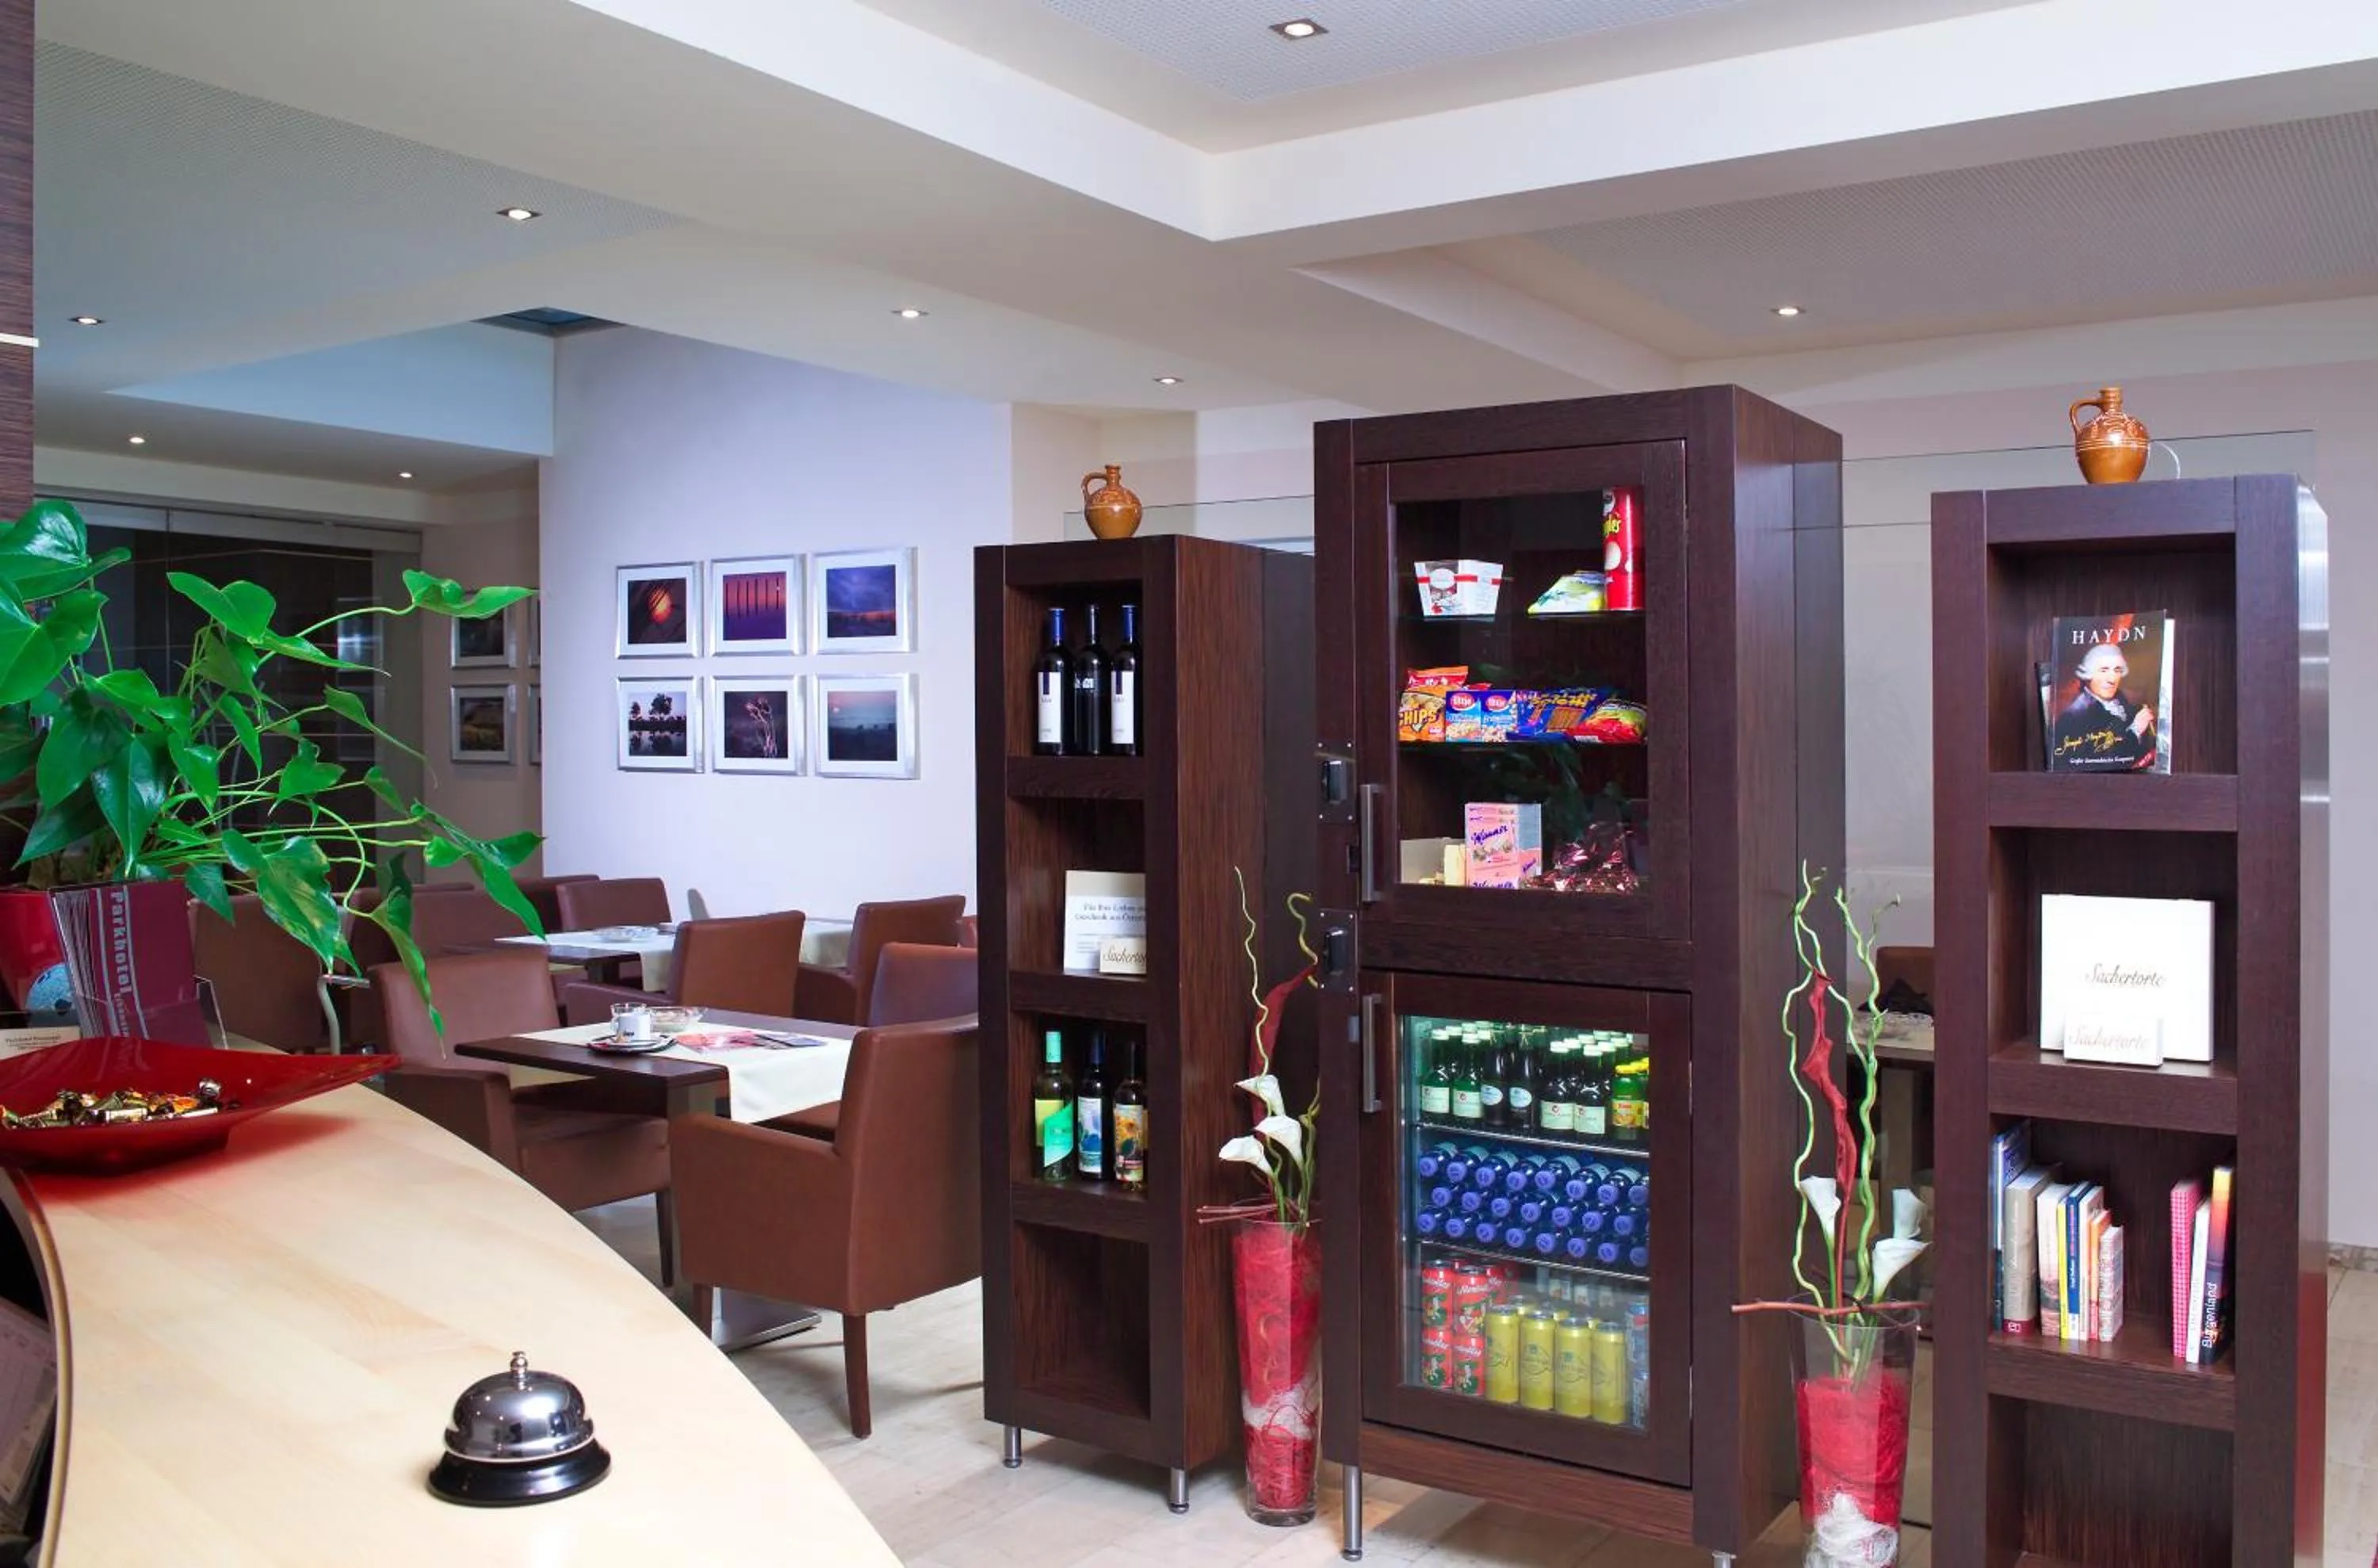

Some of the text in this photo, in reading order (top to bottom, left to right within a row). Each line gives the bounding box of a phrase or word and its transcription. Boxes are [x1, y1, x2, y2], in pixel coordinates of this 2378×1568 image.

[2072, 625, 2147, 644] HAYDN
[111, 890, 132, 992] Parkhotel
[2085, 962, 2165, 987] Sachertorte
